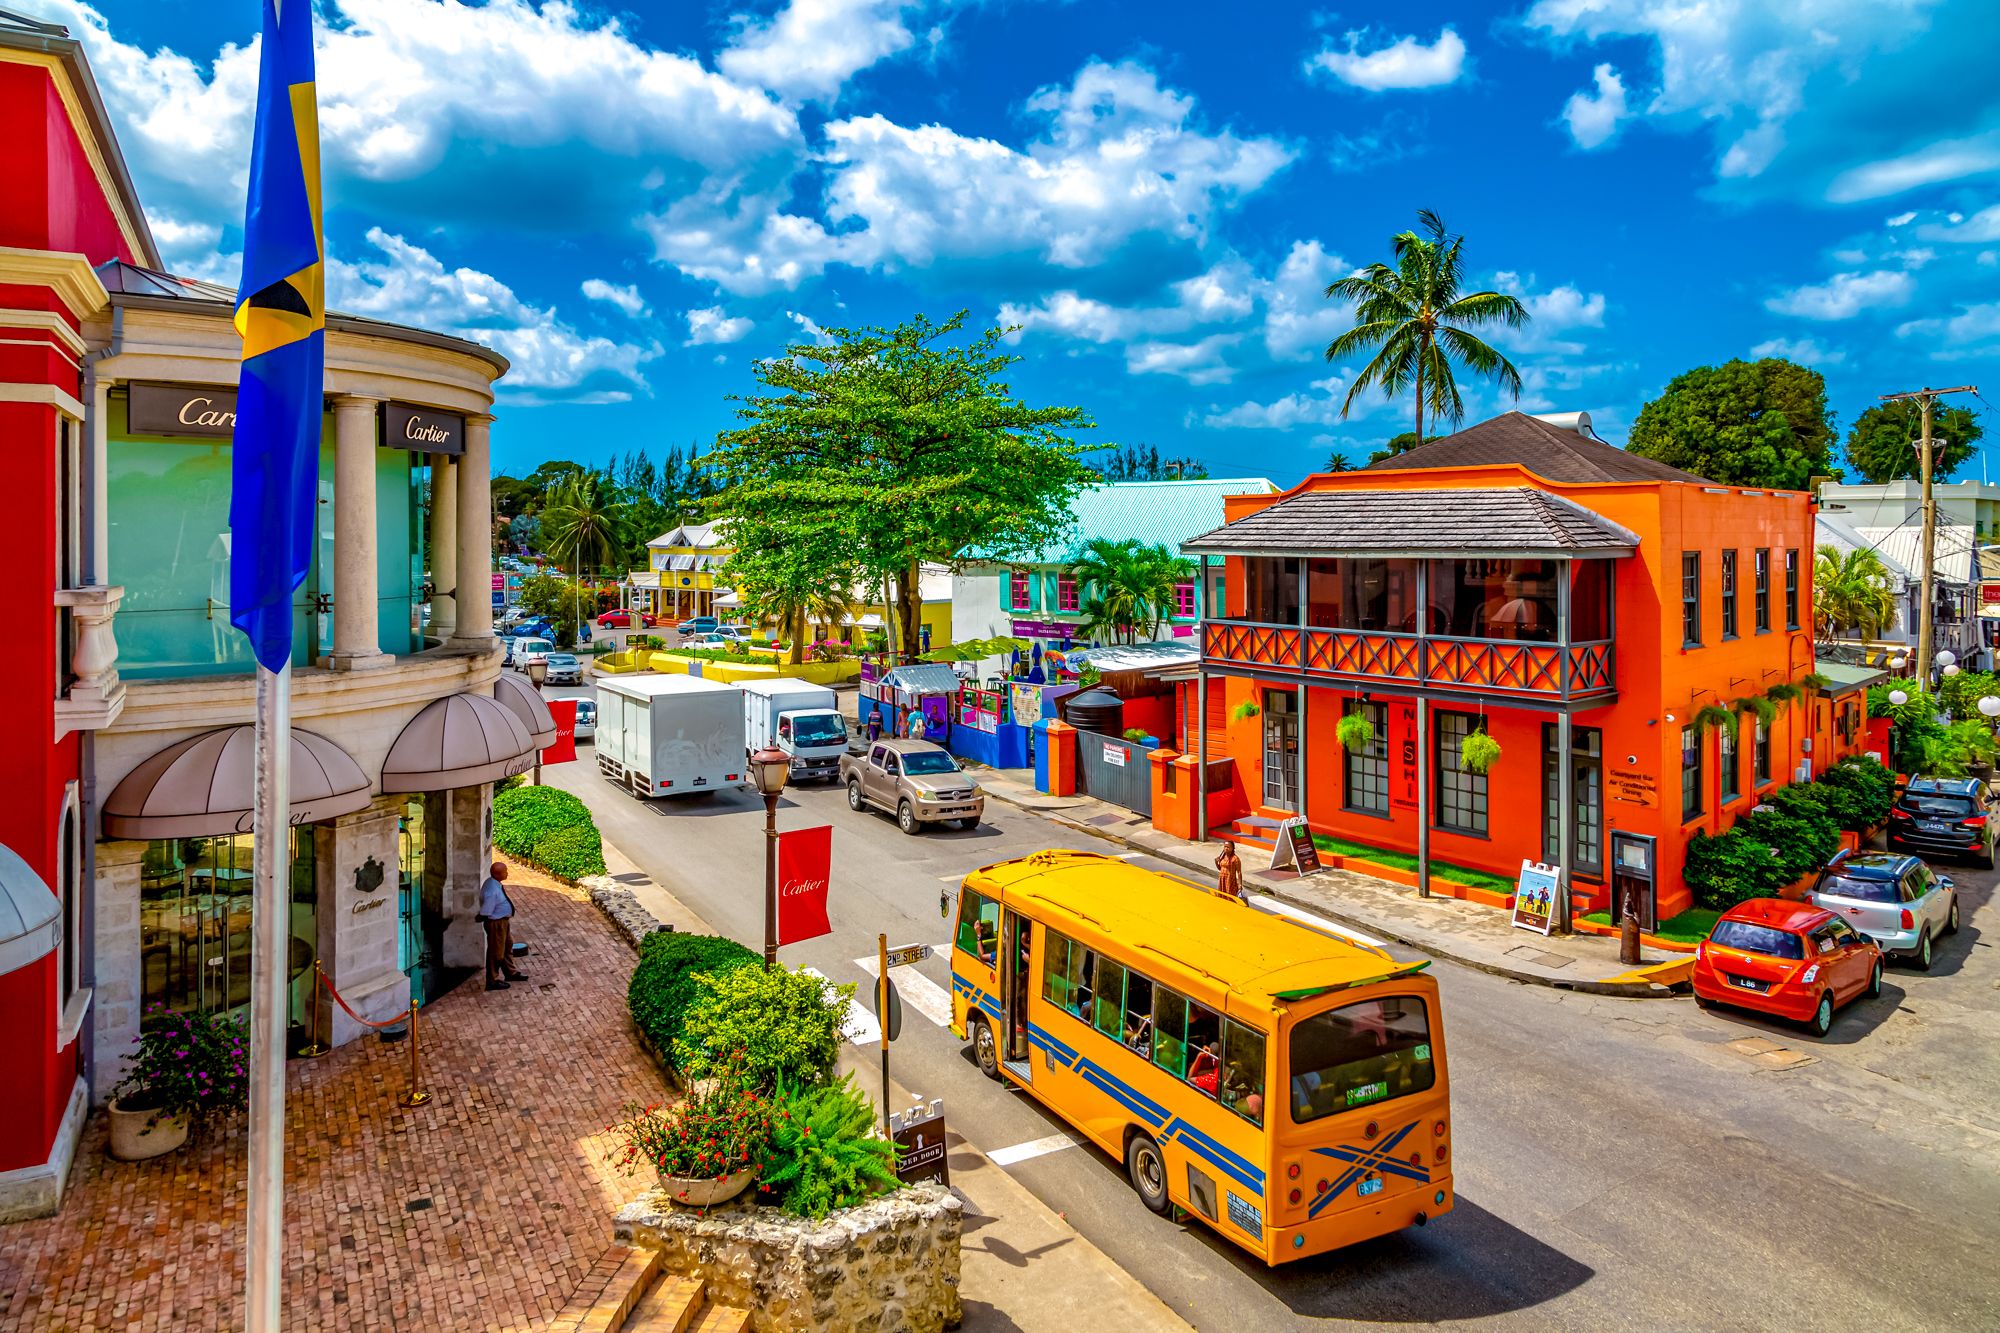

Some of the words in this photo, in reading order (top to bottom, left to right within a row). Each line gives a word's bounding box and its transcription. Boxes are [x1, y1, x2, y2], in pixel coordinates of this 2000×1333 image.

[406, 415, 450, 443] Cartier
[555, 729, 573, 737] rtier
[504, 759, 532, 777] Cartier
[782, 879, 825, 897] Cartier
[352, 898, 386, 914] Cartier
[903, 946, 929, 962] STREET
[920, 1148, 940, 1160] DOOR
